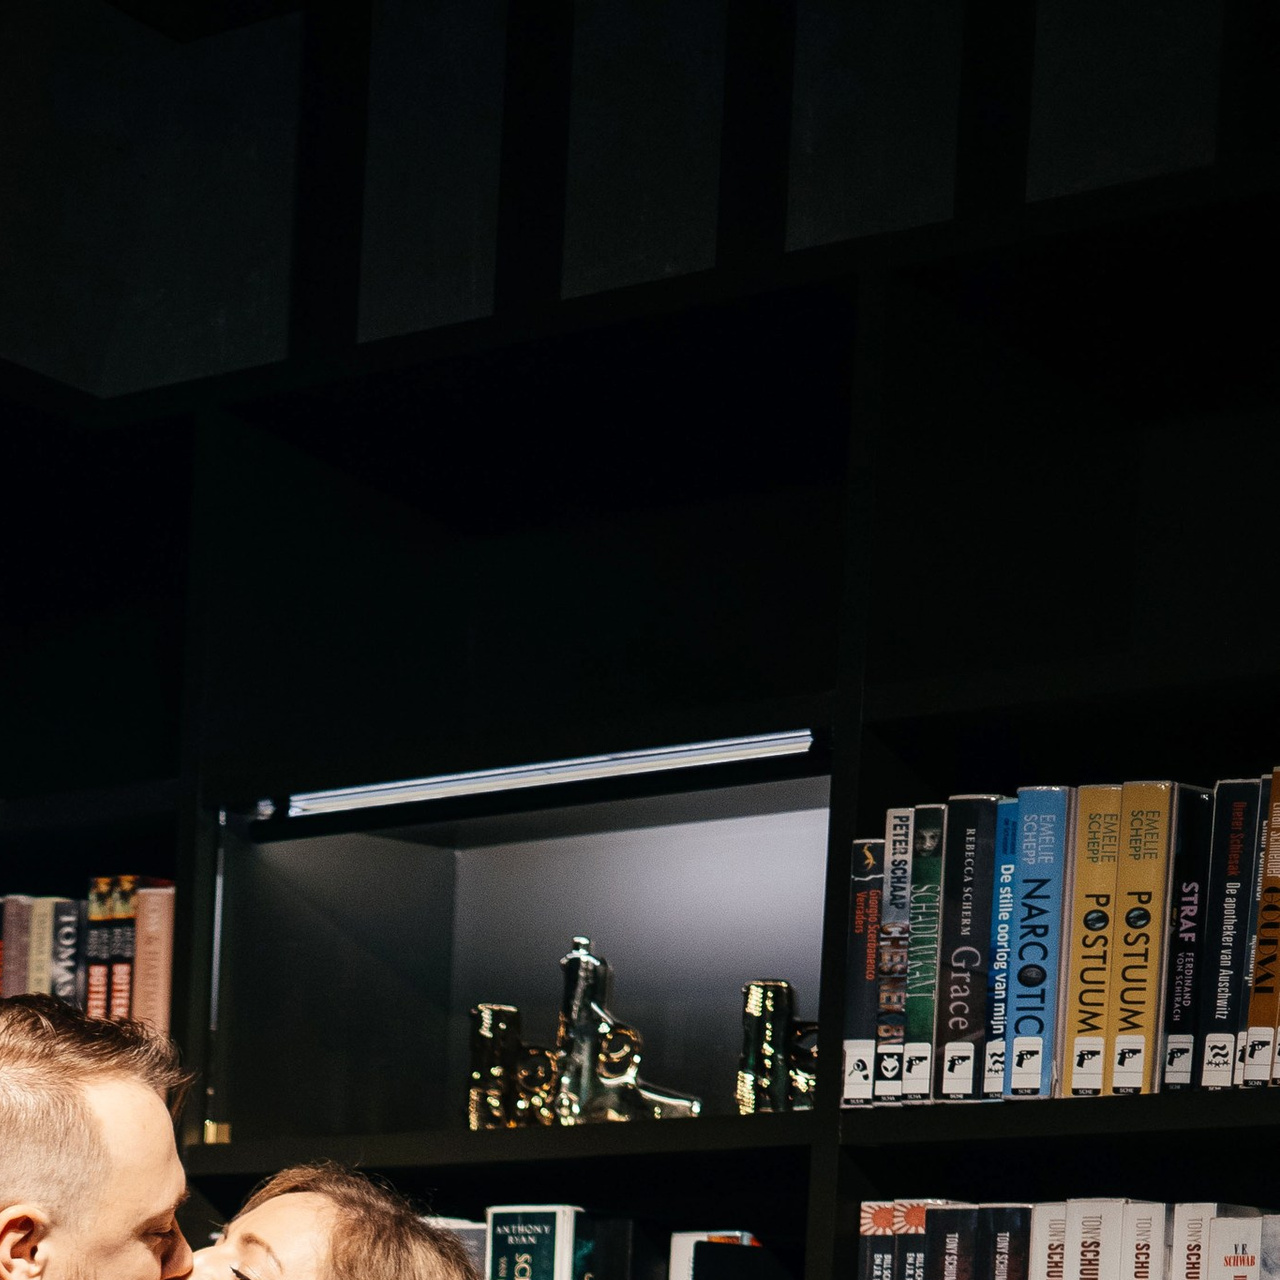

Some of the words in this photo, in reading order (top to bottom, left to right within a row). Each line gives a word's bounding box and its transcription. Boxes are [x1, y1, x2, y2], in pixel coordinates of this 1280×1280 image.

[891, 815, 910, 855] PETER
[1022, 814, 1038, 865] SCHEPP
[1037, 814, 1056, 865] EMELIE
[1086, 813, 1102, 864] SCHEPP
[1101, 813, 1118, 863] EMELIE
[1128, 809, 1145, 861] SCHEPP
[1143, 809, 1160, 860] EMELIE
[889, 857, 908, 911] SCHAAP
[997, 882, 1012, 918] stille
[961, 886, 974, 937] SCHERM
[1178, 881, 1200, 943] STRAF
[992, 920, 1011, 970] oorlog
[1014, 877, 1051, 1036] NARCOTIC
[1076, 893, 1111, 1034] POSTUUM
[1117, 890, 1153, 1033] POSTUUM
[948, 945, 981, 1031] Grace
[993, 971, 1007, 997] van
[991, 999, 1006, 1035] mijn
[494, 1223, 552, 1234] ANTHONY
[507, 1234, 538, 1245] RYAN
[1223, 1255, 1256, 1268] SCHWAB
